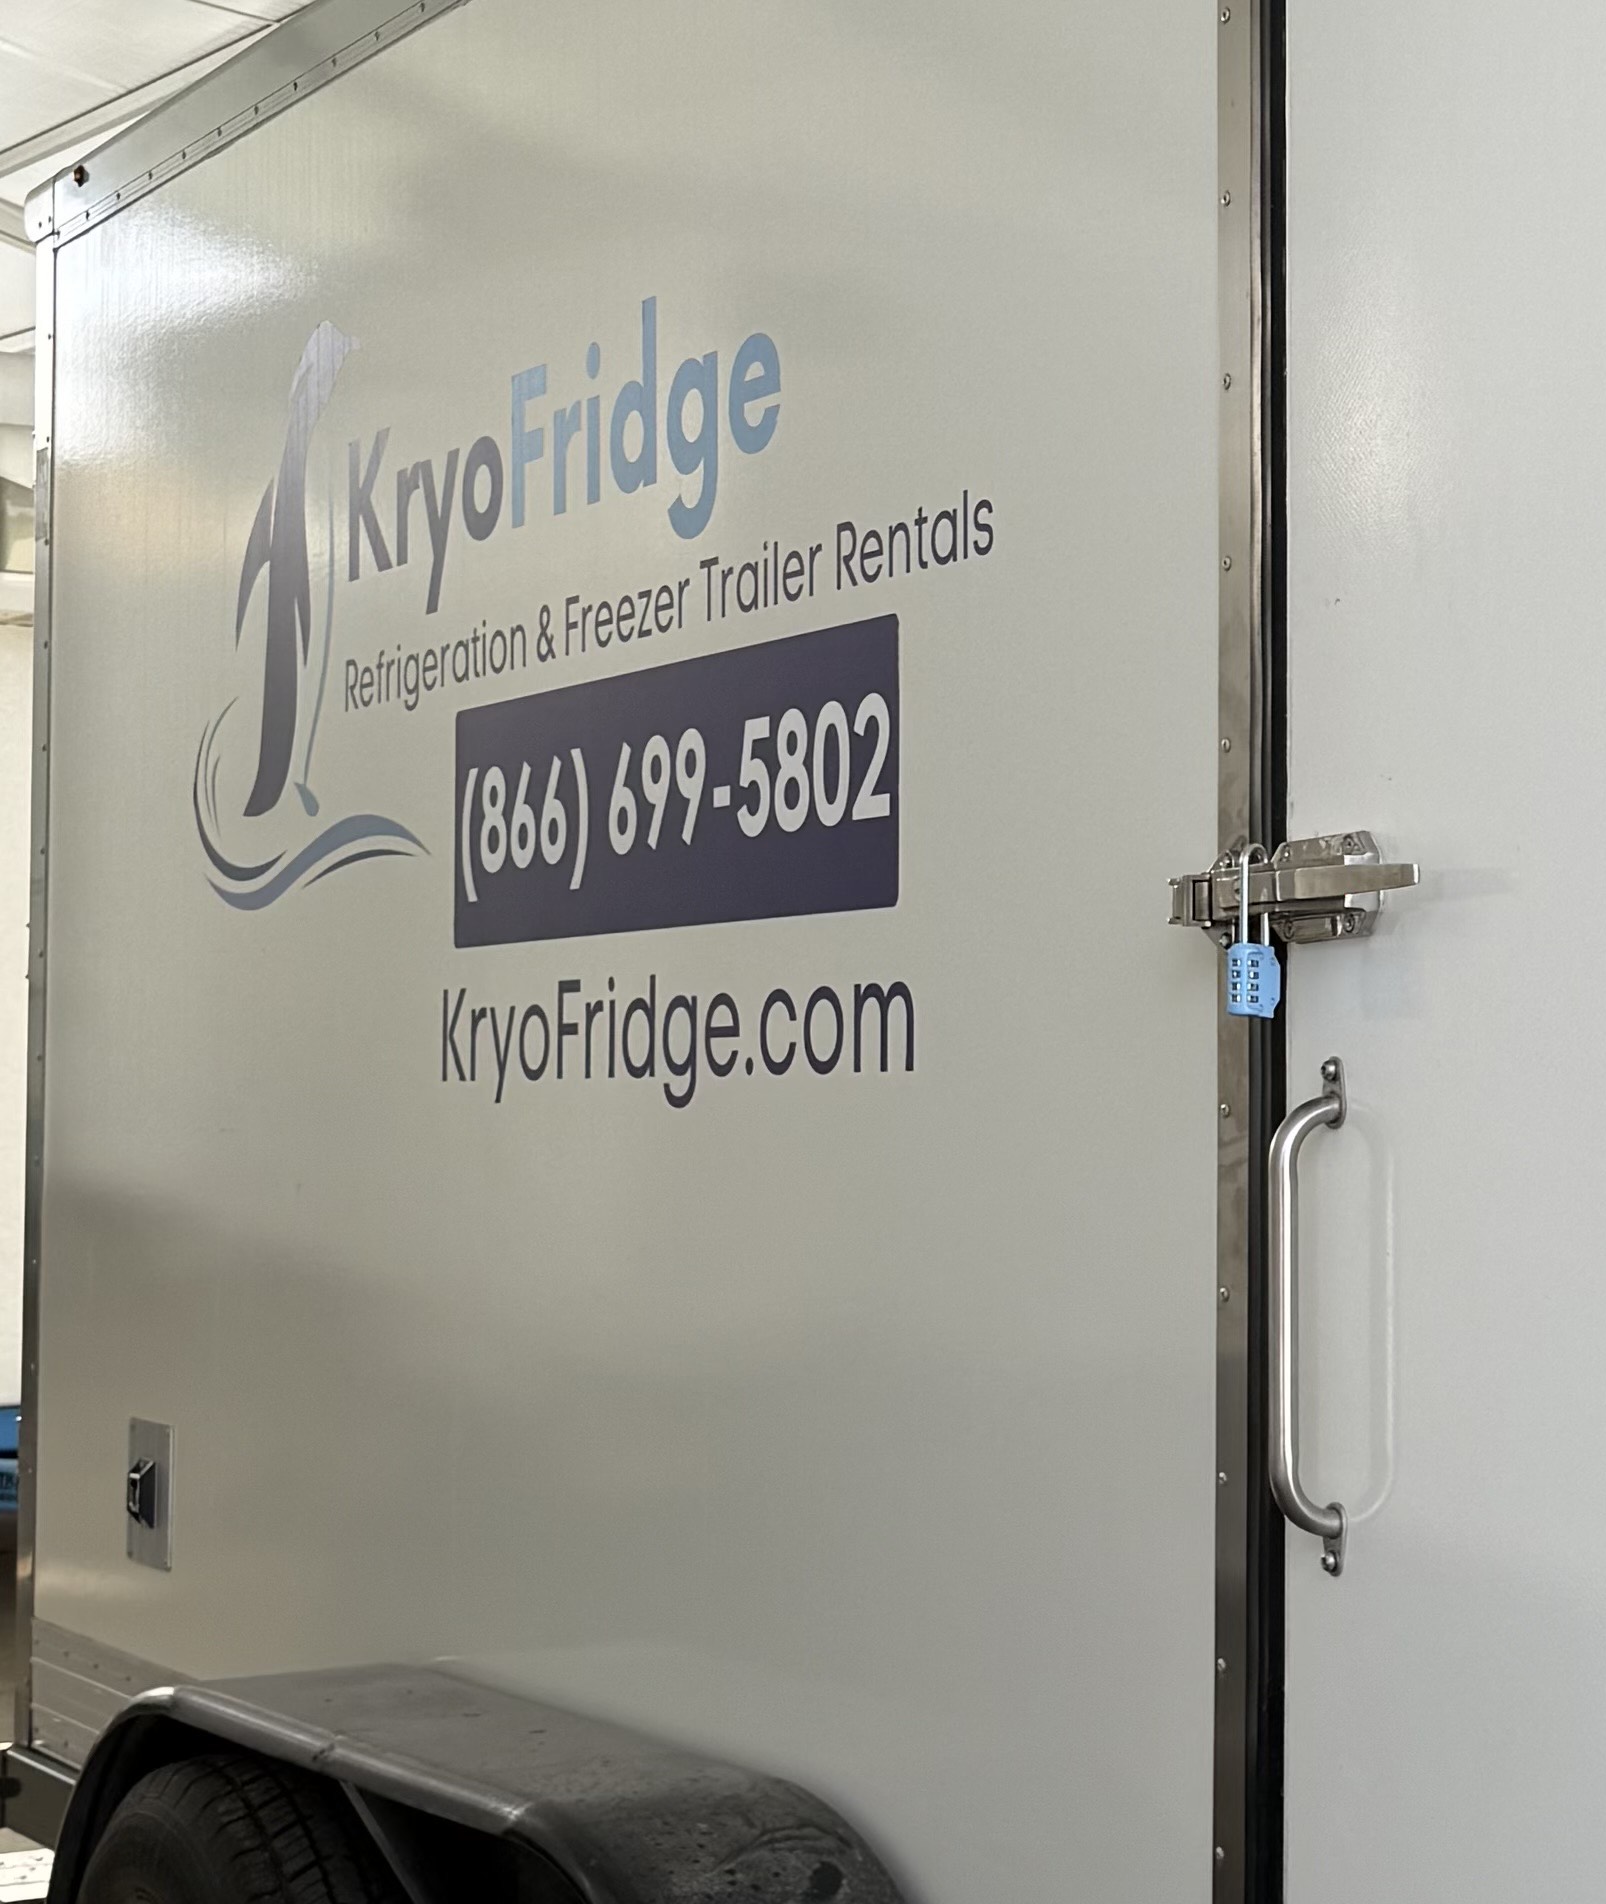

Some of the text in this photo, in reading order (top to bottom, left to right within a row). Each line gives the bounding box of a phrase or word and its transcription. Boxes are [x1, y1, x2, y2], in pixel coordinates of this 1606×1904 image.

[347, 296, 782, 615] KryoFridge
[344, 488, 995, 713] Refrigeration & Freezer Trailer Rentals
[462, 692, 891, 902] (866) 699-5802
[441, 973, 915, 1110] KryoFridge.com
